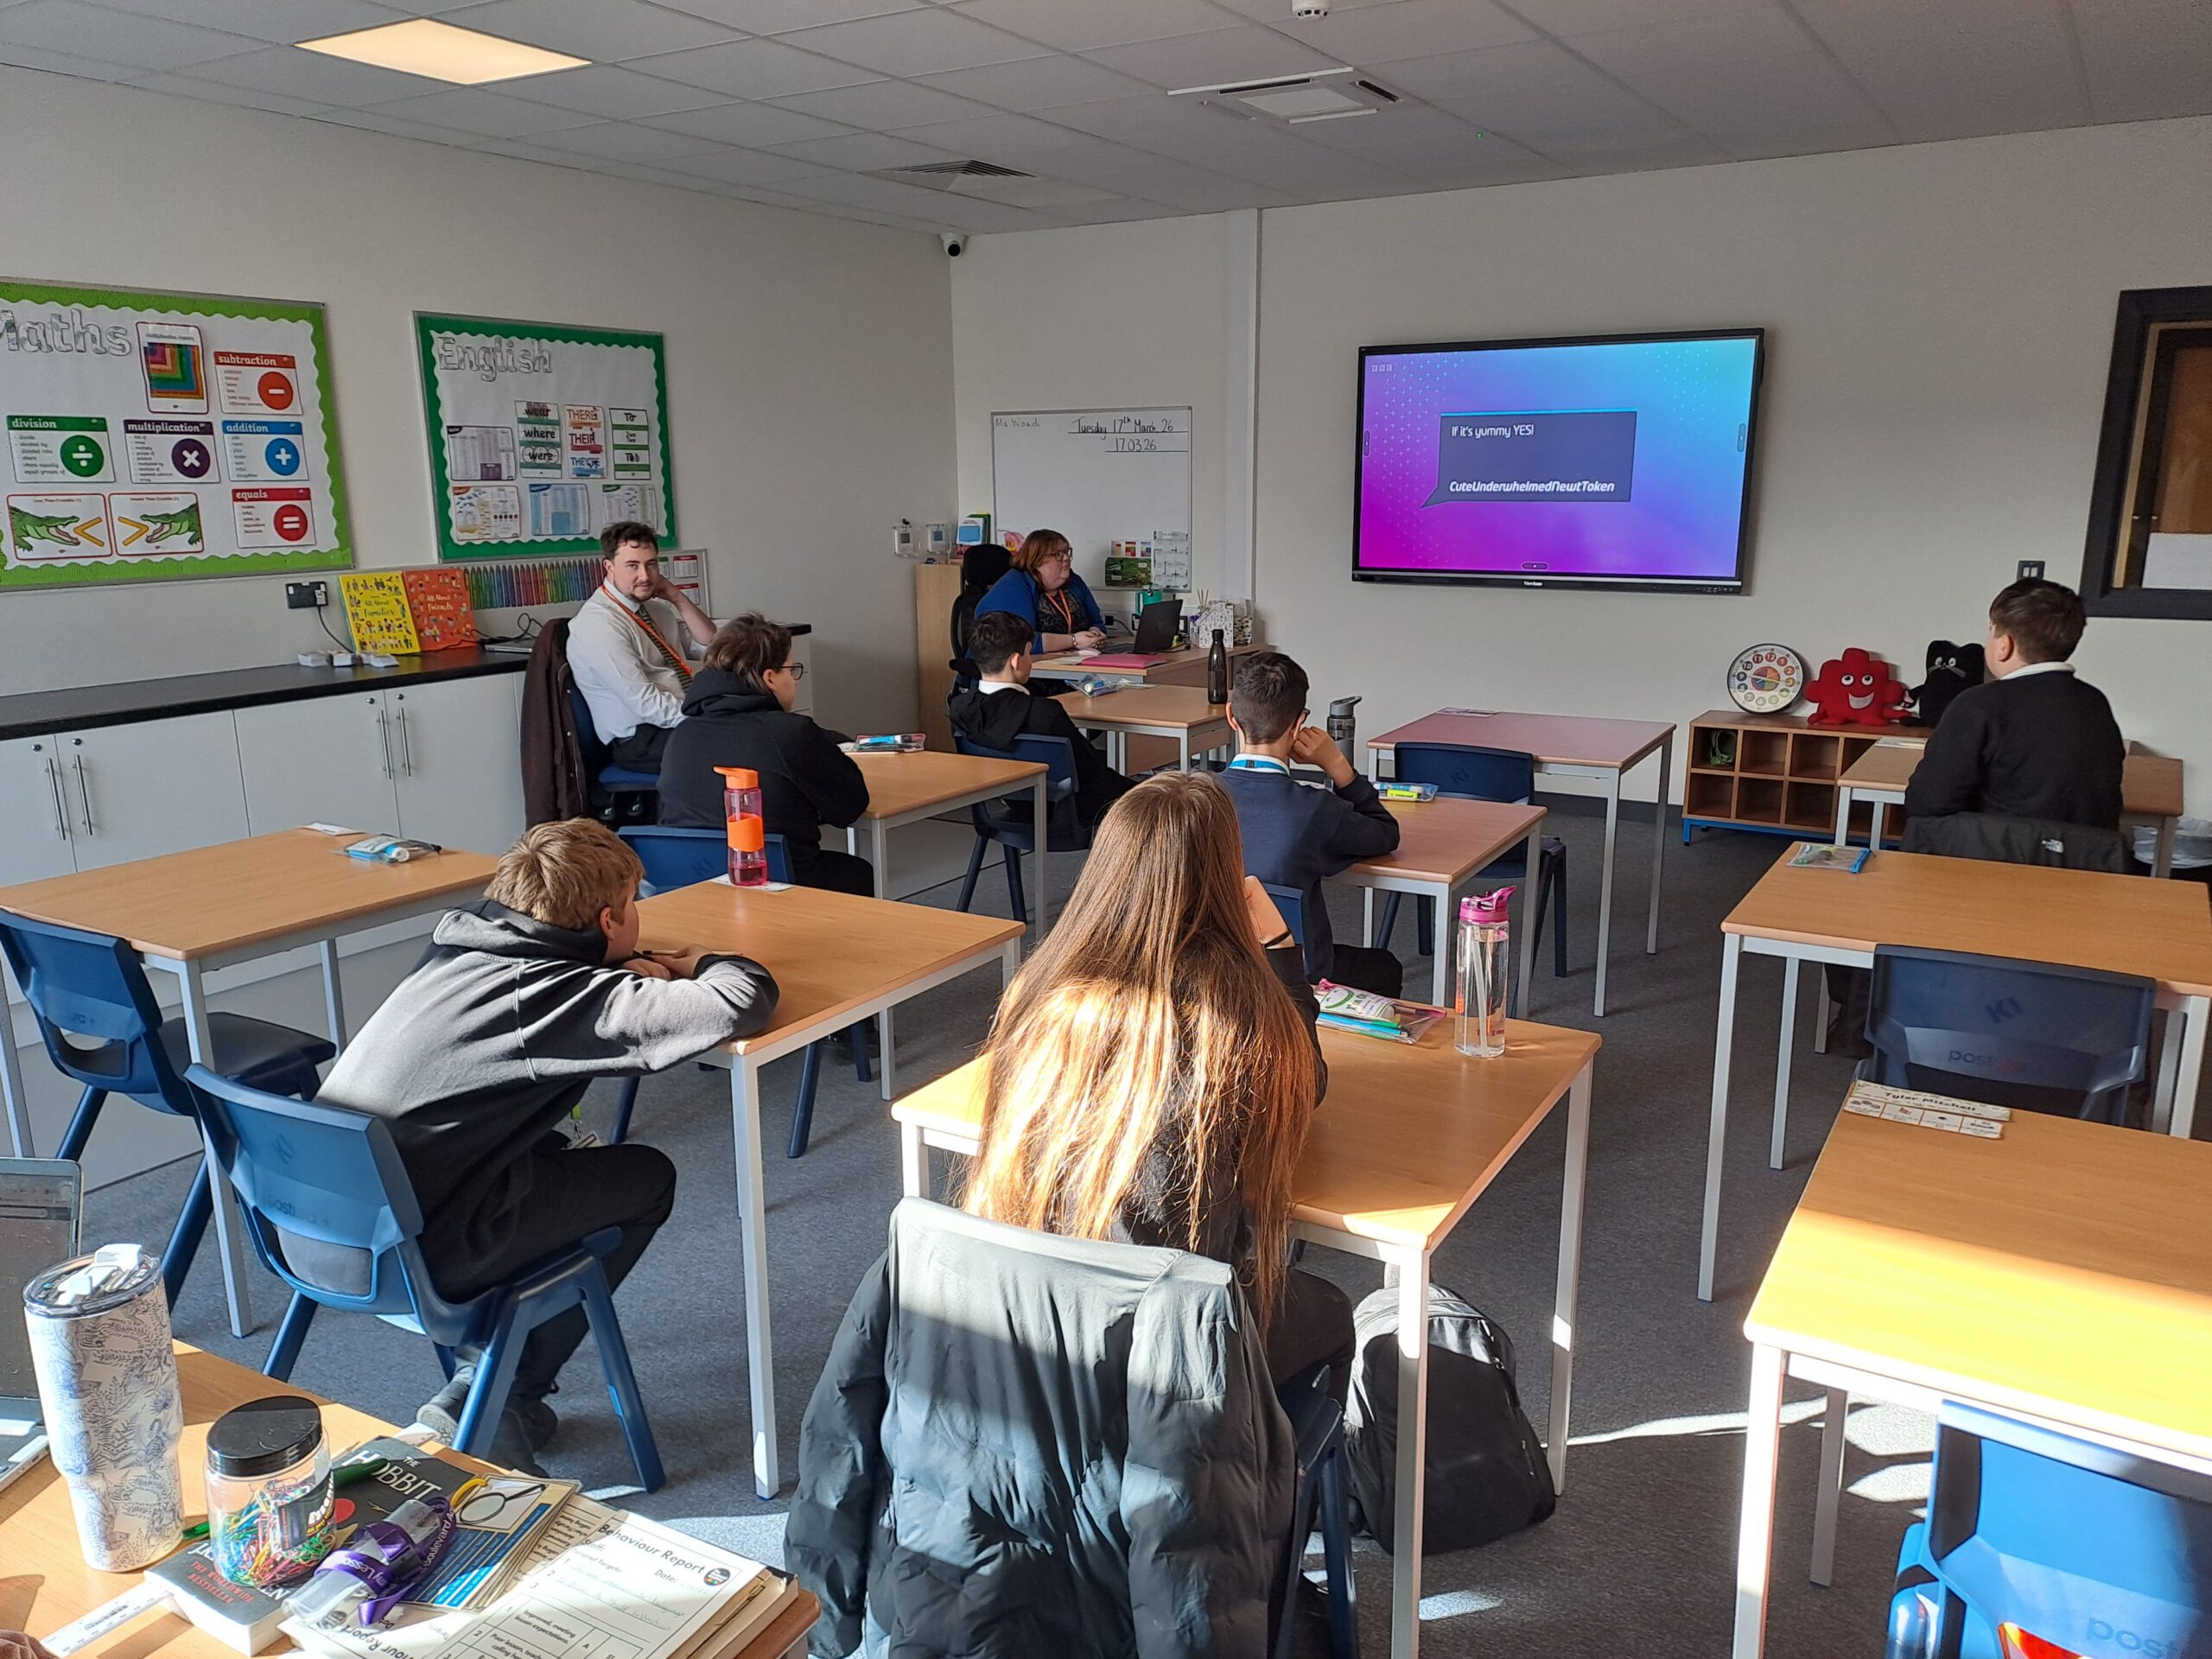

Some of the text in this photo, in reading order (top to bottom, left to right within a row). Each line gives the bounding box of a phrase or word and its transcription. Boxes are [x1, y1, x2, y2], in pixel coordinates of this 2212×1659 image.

[218, 354, 277, 365] subtraction
[437, 337, 552, 382] English
[11, 417, 57, 429] division
[127, 422, 200, 433] multiplication
[226, 423, 269, 432] addition
[1071, 416, 1107, 440] Tuesday
[524, 427, 556, 438] where
[569, 432, 596, 444] THEIR
[1451, 425, 1459, 436] If
[1460, 425, 1473, 436] it's
[1475, 427, 1511, 438] yummy
[529, 452, 554, 461] were
[1450, 480, 1615, 493] CuteUnderwhelmedNewtToken
[235, 489, 268, 500] equals
[403, 1455, 422, 1468] THE
[598, 1524, 707, 1574] Behaviour Report
[190, 1561, 208, 1574] THE
[207, 1571, 256, 1604] WORLDWIDE
[654, 1569, 678, 1584] Date:
[188, 1573, 235, 1605] BESTSELLER
[378, 1617, 396, 1630] Dat
